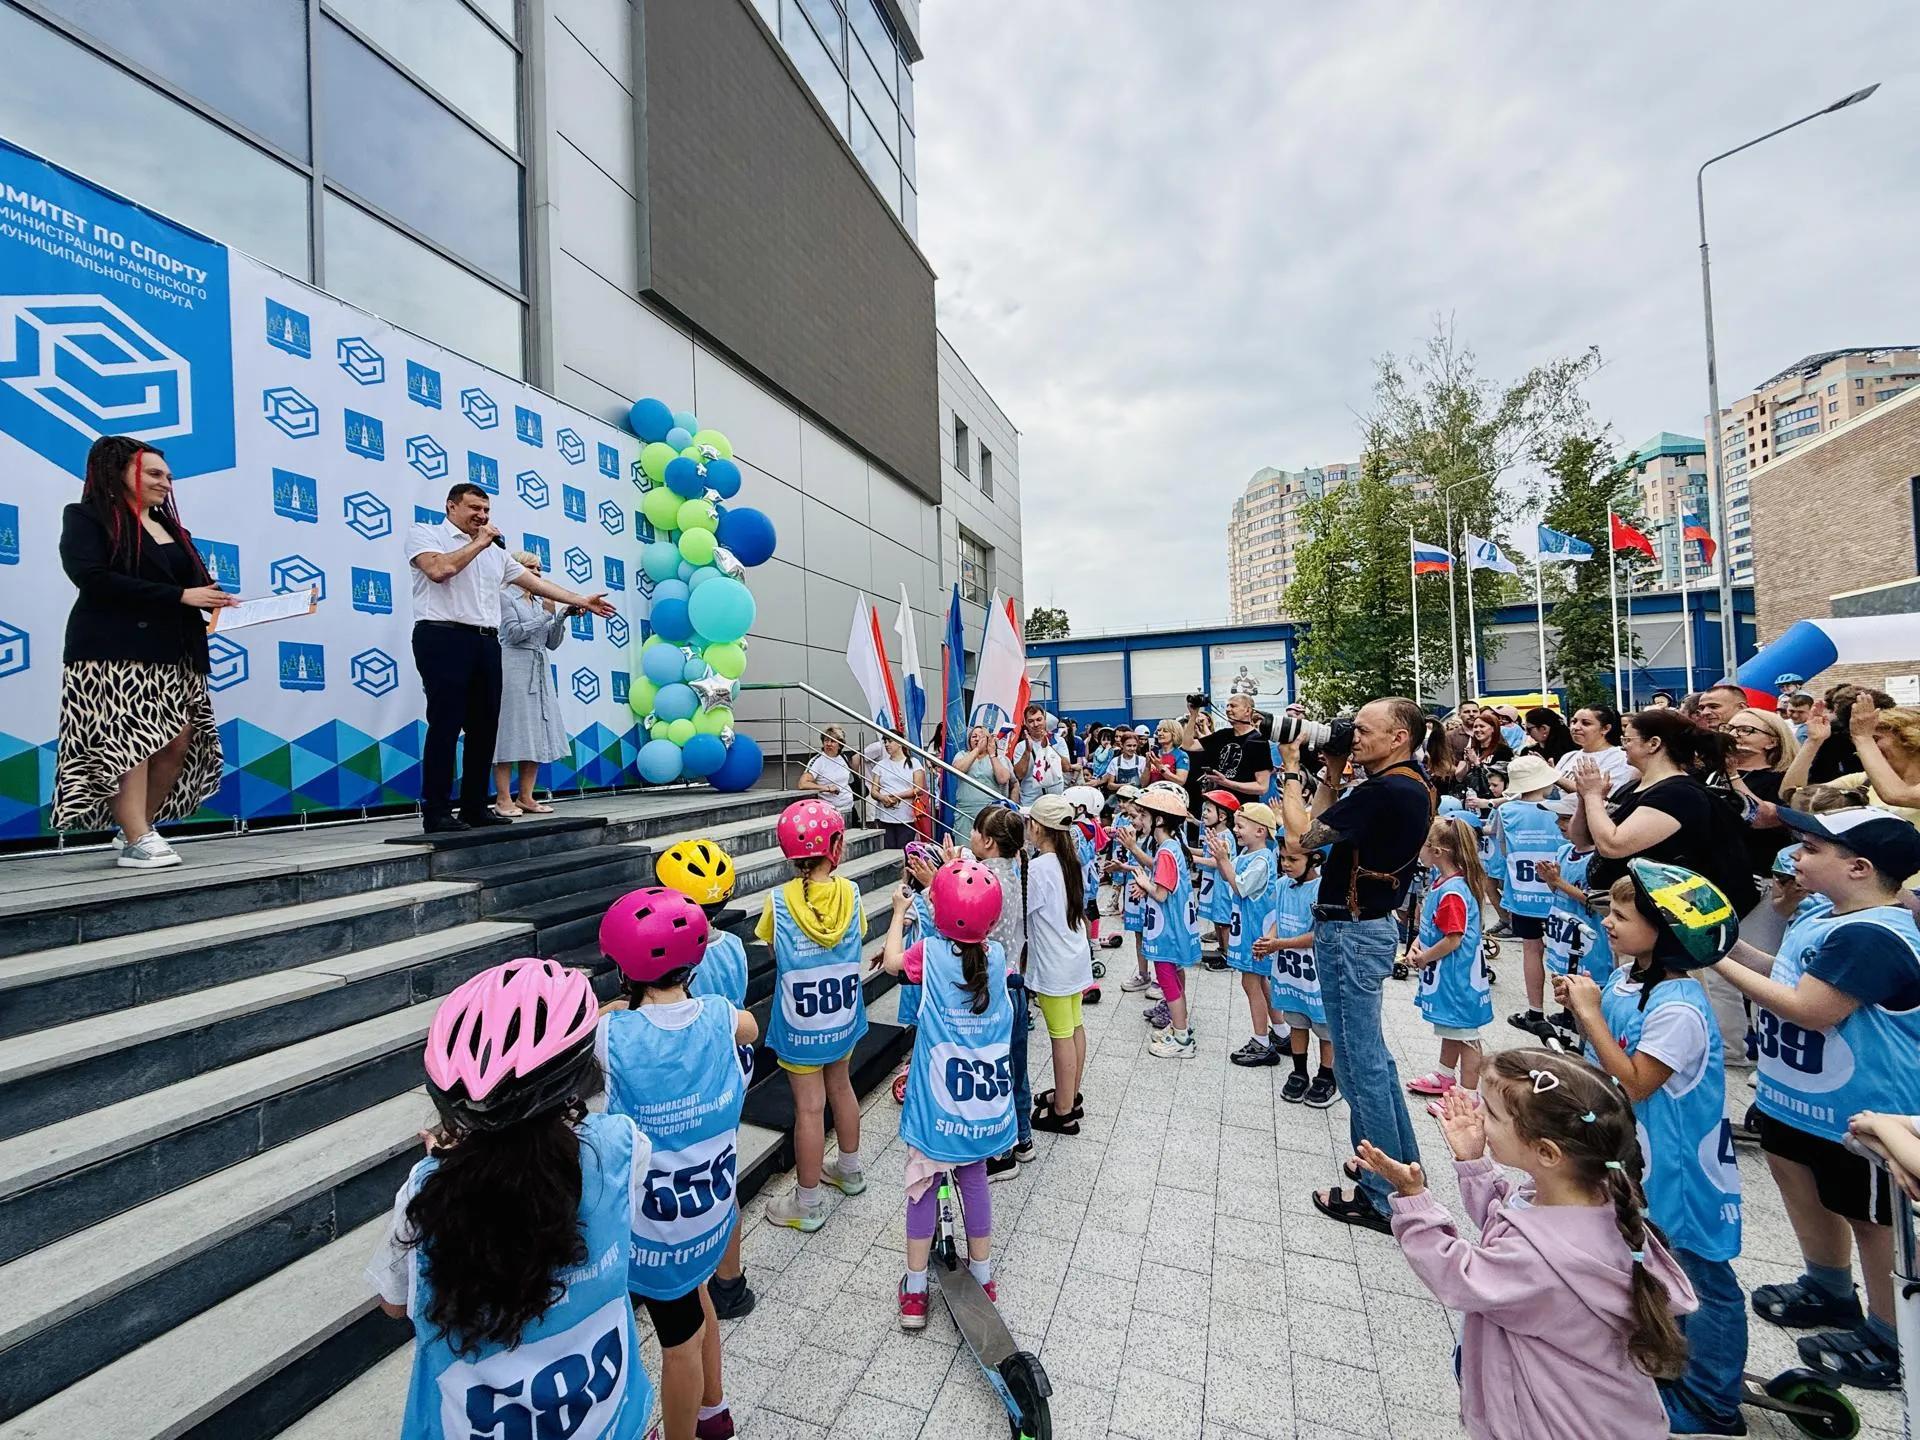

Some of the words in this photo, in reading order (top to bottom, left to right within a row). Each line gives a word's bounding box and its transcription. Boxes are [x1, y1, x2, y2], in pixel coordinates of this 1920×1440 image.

[94, 225, 124, 250] ПО
[130, 240, 208, 283] СПОРТУ
[119, 256, 207, 300] РАМЕНСКОГО
[145, 282, 194, 311] ОКРУГА
[793, 973, 858, 1018] 586
[946, 1055, 1012, 1102] 635
